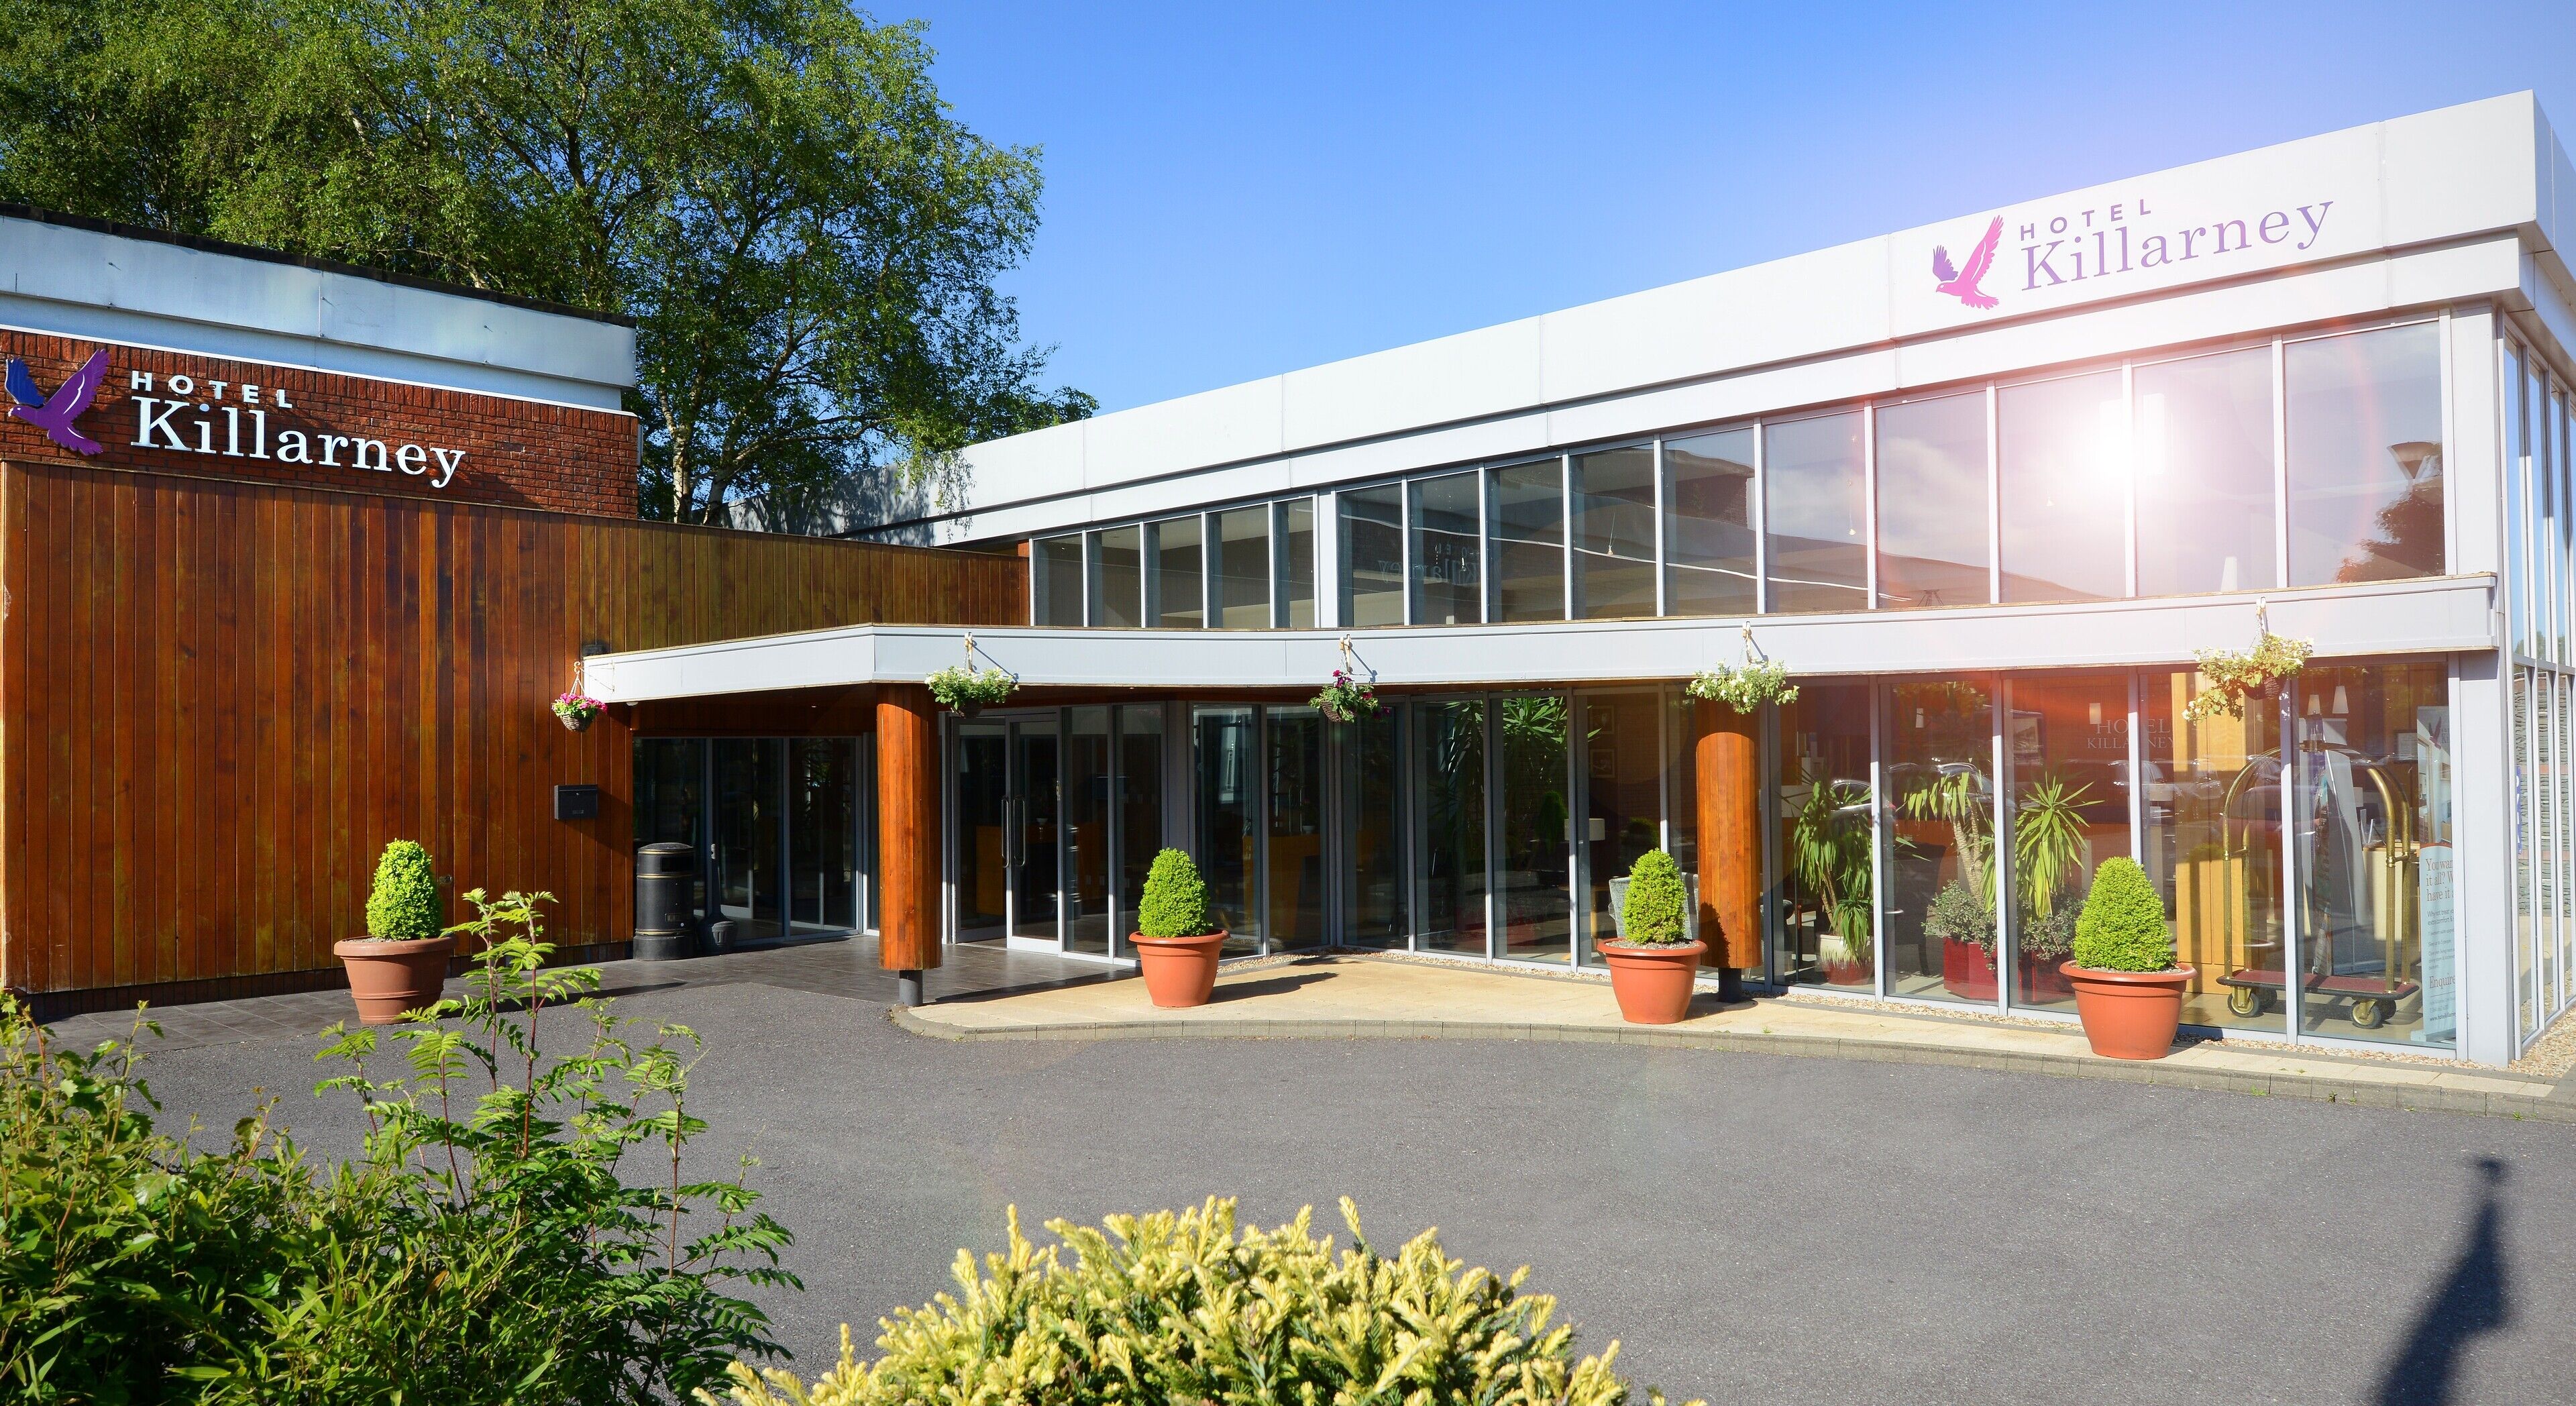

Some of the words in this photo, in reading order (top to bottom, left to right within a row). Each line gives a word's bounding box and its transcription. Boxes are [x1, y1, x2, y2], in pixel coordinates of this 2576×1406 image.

[2021, 199, 2151, 241] HOTEL
[2021, 201, 2333, 291] Killarney
[131, 370, 292, 409] HOTEL
[131, 396, 466, 488] Killarney
[2096, 718, 2171, 735] HOEL
[2087, 737, 2173, 749] KILLANEY
[2426, 858, 2439, 871] You
[2426, 873, 2433, 886] it
[2434, 871, 2446, 885] all?
[2426, 888, 2443, 902] have
[2445, 886, 2451, 899] it
